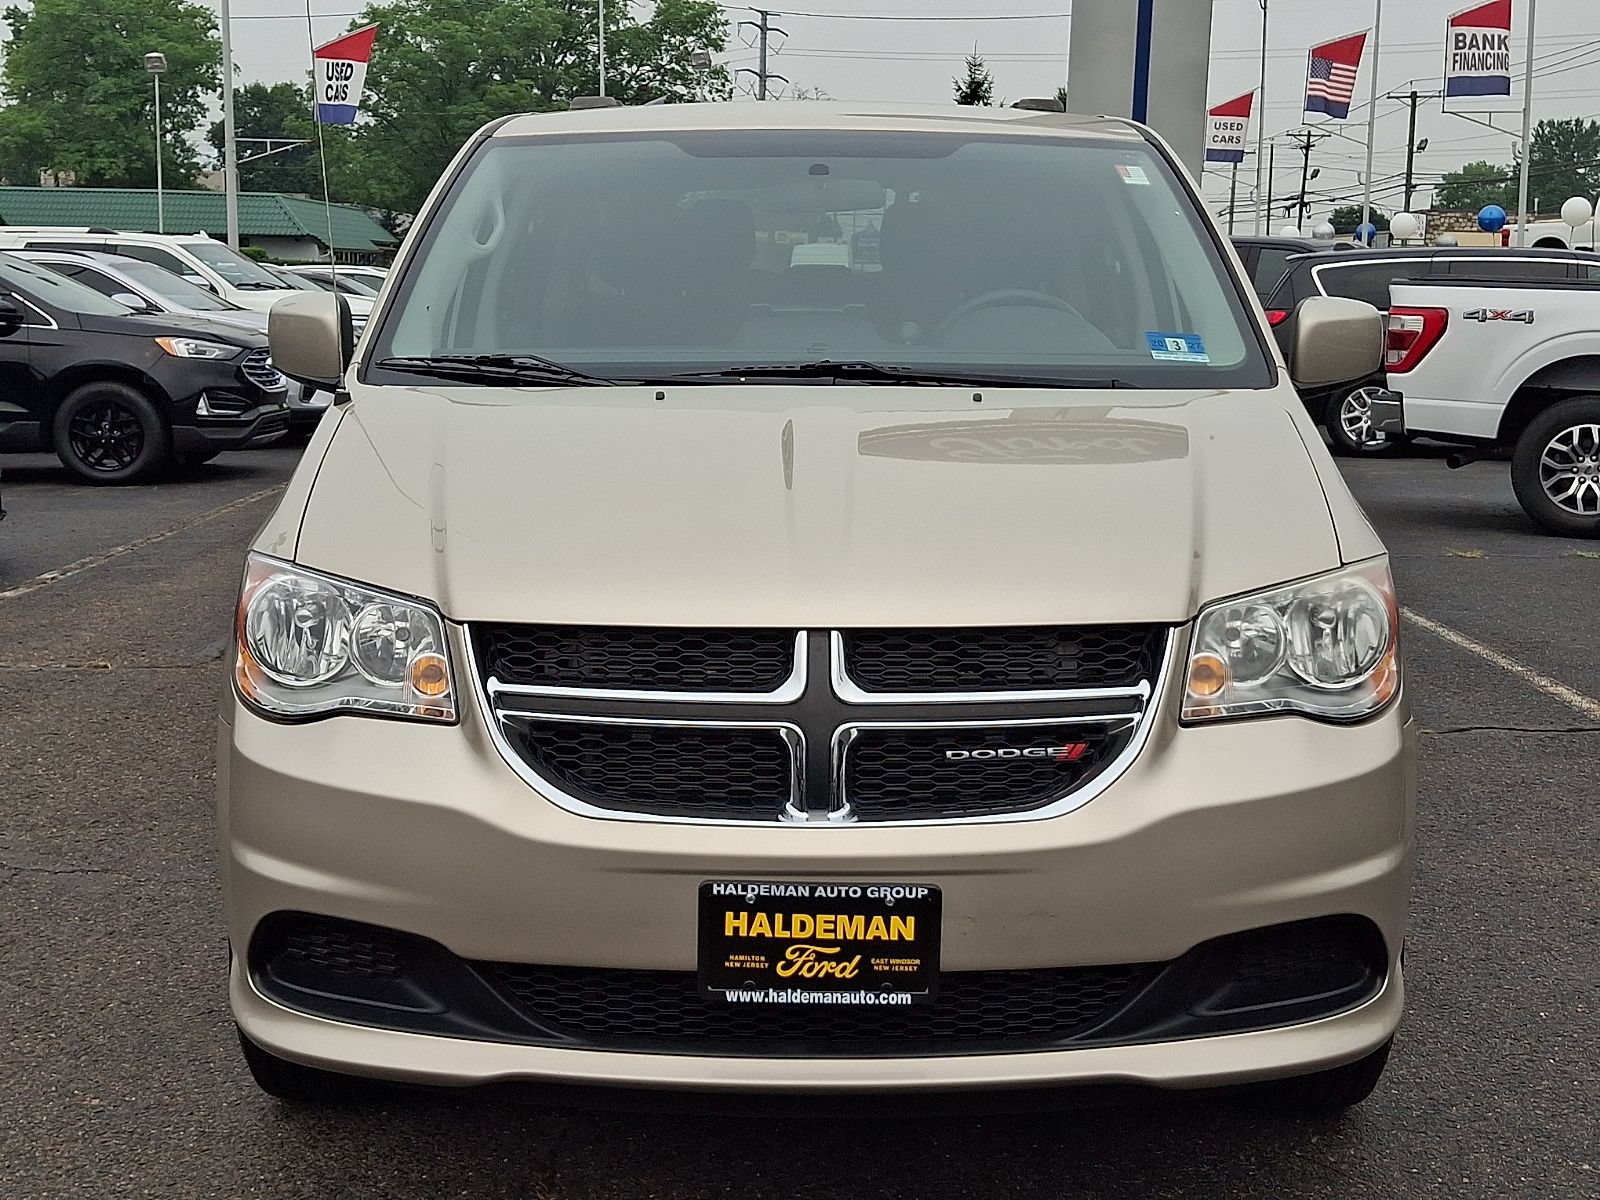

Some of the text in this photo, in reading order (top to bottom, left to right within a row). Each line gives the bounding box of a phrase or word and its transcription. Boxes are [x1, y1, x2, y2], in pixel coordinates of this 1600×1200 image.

[1454, 32, 1509, 52] BANK
[1452, 51, 1510, 71] FINANCING
[1214, 121, 1244, 131] USED
[1212, 134, 1242, 145] CARS
[1172, 340, 1182, 351] 3
[946, 747, 1069, 760] DODGE
[712, 883, 929, 899] HALDEMAN AUTO GROUP
[724, 911, 916, 941] HALDEMAN
[729, 954, 766, 962] HAMILTON
[776, 944, 862, 979] Ford
[725, 988, 912, 1005] www.haldemanauto.com
